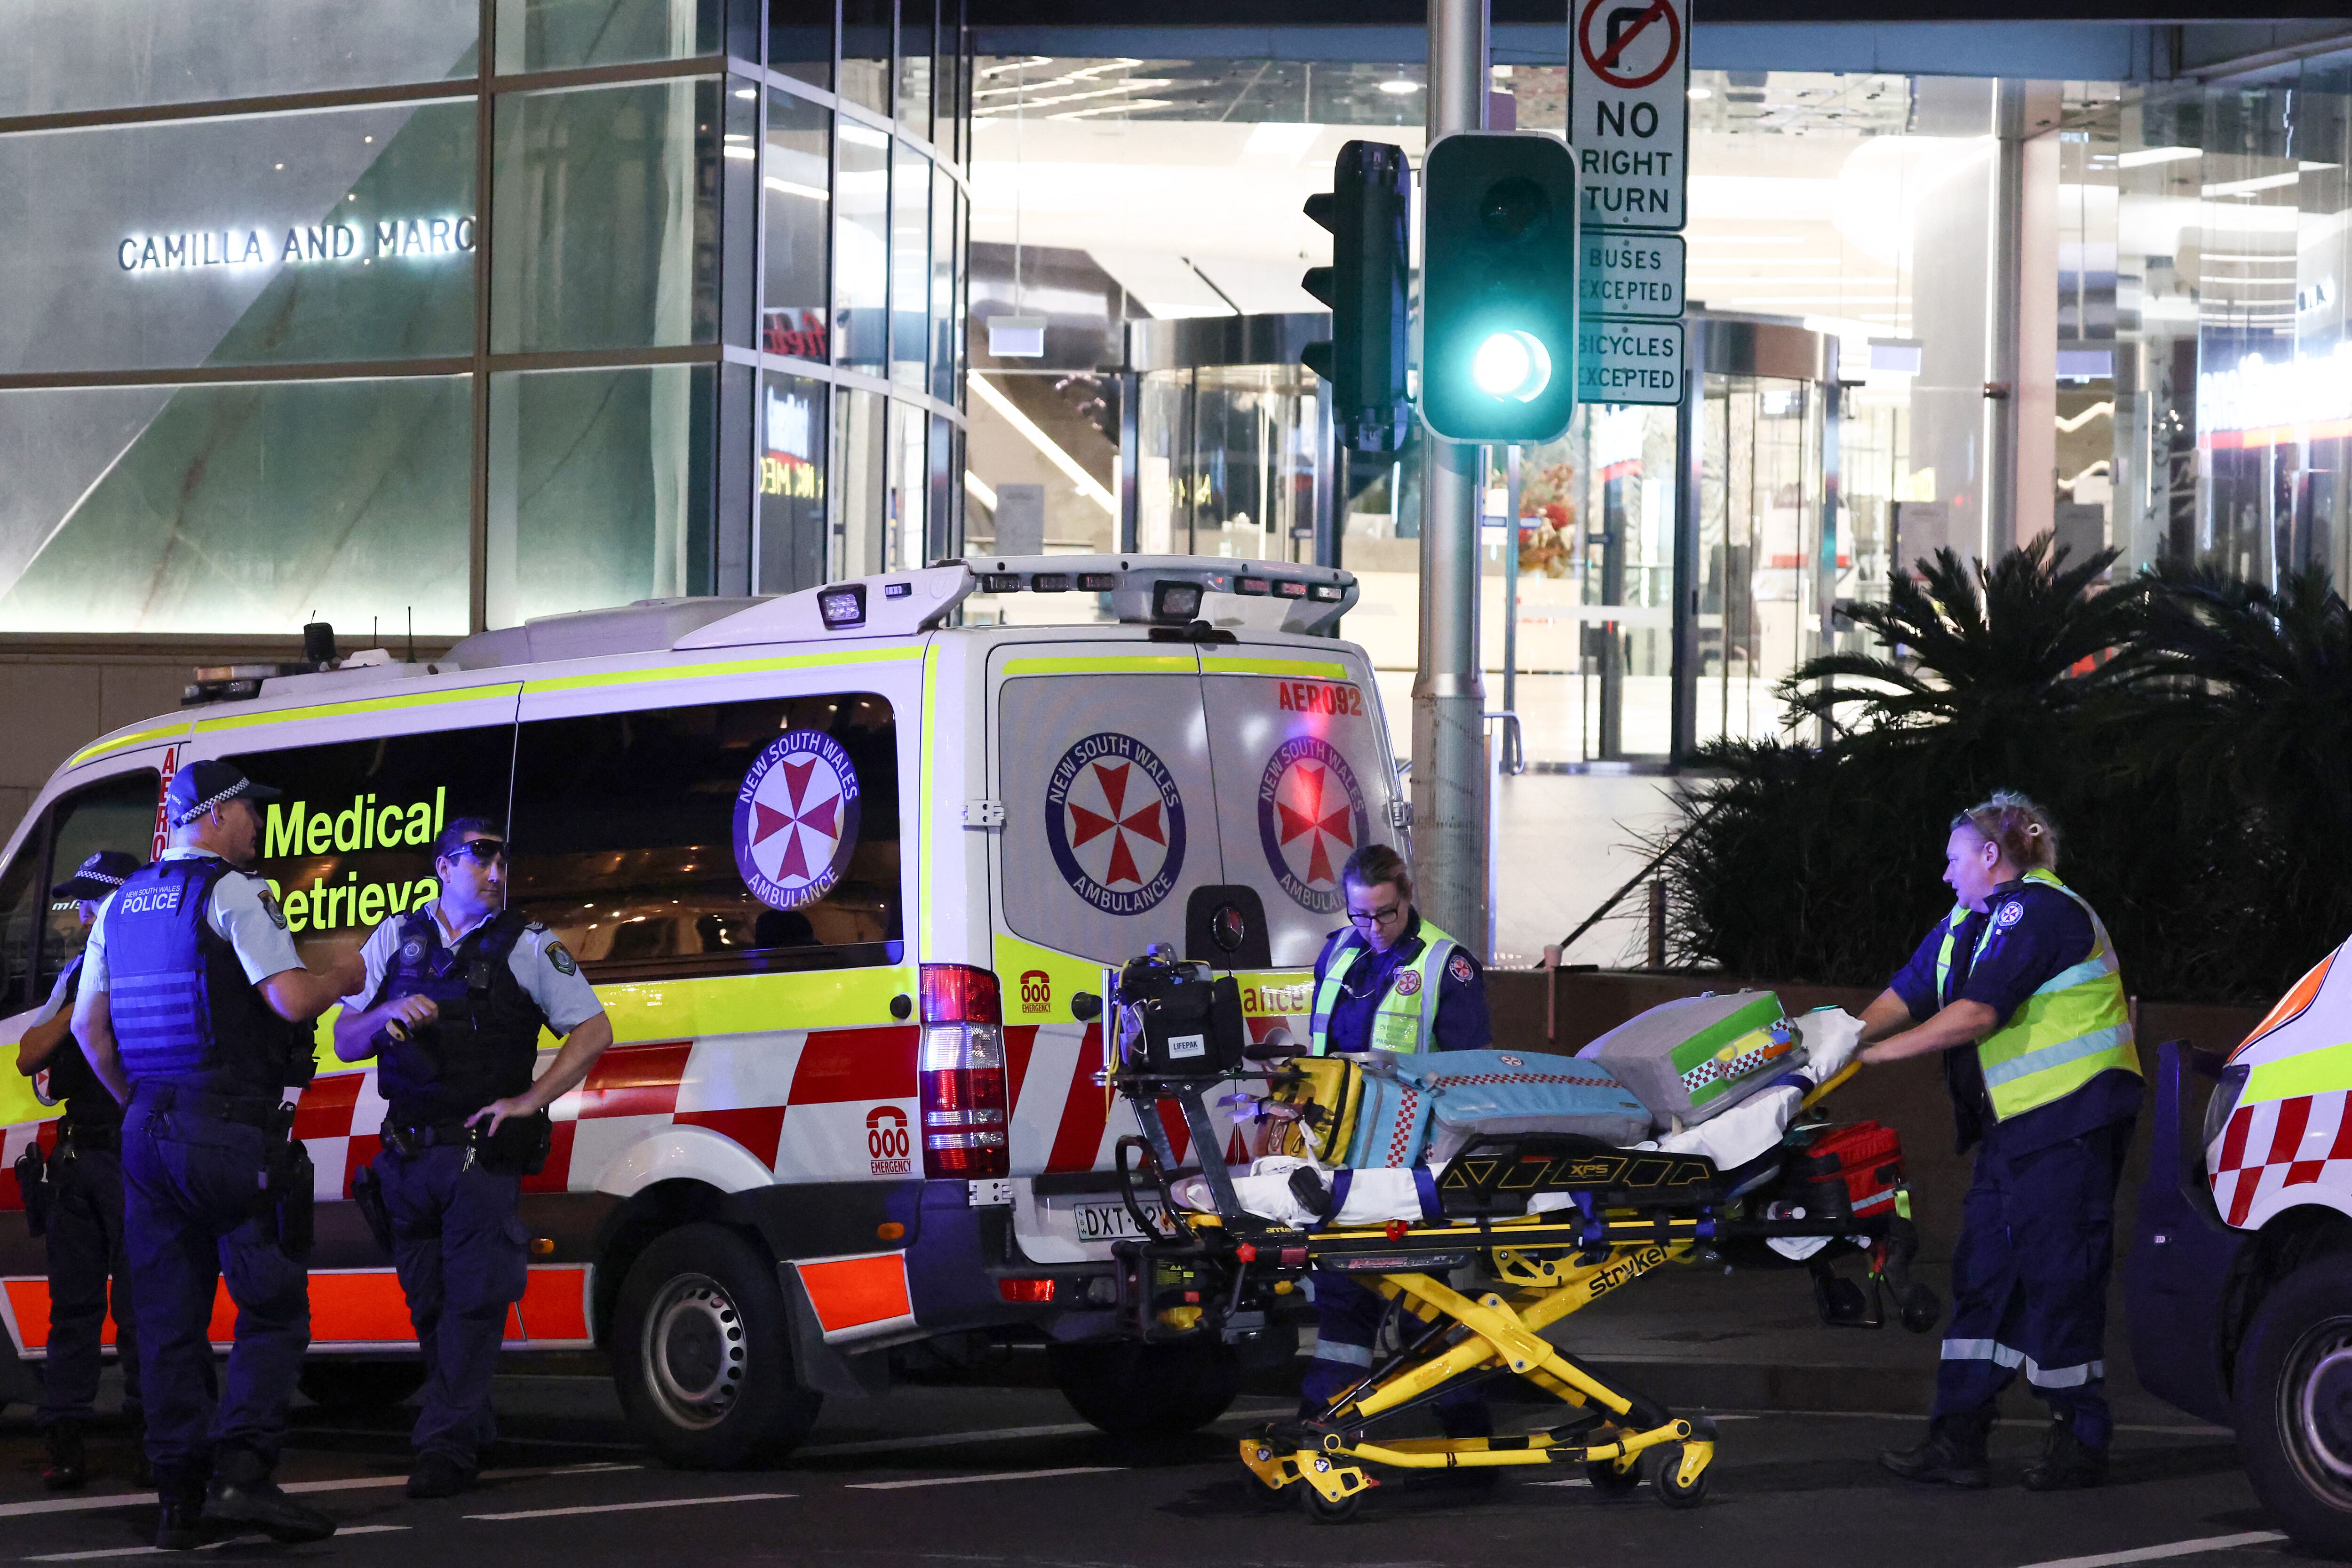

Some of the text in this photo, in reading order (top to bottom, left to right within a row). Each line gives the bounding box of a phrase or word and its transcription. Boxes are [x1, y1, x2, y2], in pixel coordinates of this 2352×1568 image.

[1597, 101, 1658, 138] NO
[1581, 149, 1672, 176] RIGHT
[1585, 186, 1669, 213] TURN
[118, 216, 476, 271] CAMILLA AND MARC
[1590, 249, 1661, 270] BUSES
[1580, 279, 1672, 301] EXCEPTED
[1579, 336, 1674, 357] BICYCLES
[1578, 367, 1675, 389] EXCEPTED
[1280, 682, 1362, 716] AERO92
[739, 732, 858, 803] NEW SOUTH WALES
[1049, 736, 1179, 807] NEW SOUTH WALES
[1262, 739, 1364, 812] NEW SOUTH WALES
[264, 786, 445, 859] Medical
[139, 887, 158, 896] SOUTH
[748, 866, 839, 907] AMBULANCE
[1073, 872, 1172, 911] AMBULANCE
[121, 892, 179, 915] POLICE
[265, 871, 438, 932] etrieva
[1021, 984, 1050, 1003] 000
[1022, 1003, 1050, 1012] EMERGENCY
[1173, 1041, 1198, 1050] LIFEPAK
[868, 1128, 909, 1159] 000
[871, 1160, 911, 1174] EMERGENCY
[1571, 1164, 1608, 1176] XPS
[1589, 1245, 1671, 1298] stryker
